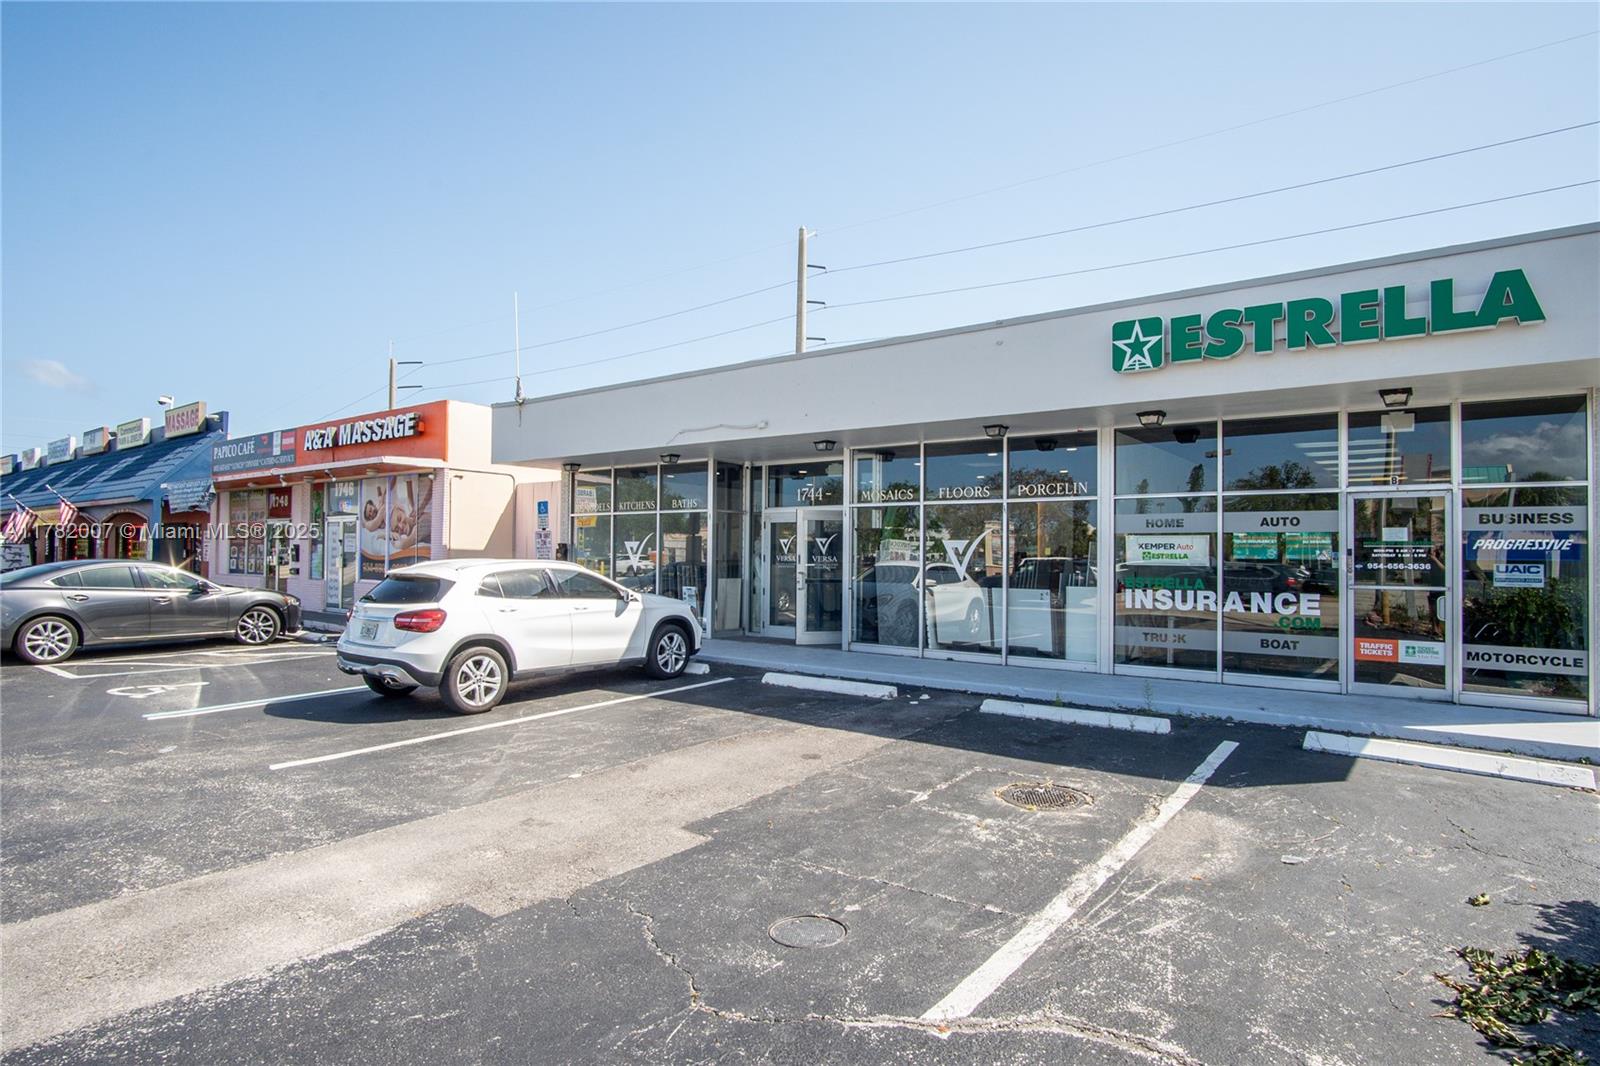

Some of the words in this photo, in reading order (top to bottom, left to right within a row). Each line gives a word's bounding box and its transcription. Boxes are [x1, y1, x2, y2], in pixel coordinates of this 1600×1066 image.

[1170, 268, 1546, 364] ESTRELLA
[165, 407, 200, 433] MASSAGE
[304, 427, 335, 451] A&A
[339, 412, 416, 446] MASSAGE
[213, 443, 237, 460] PAPICO
[238, 437, 256, 455] CAFÉ
[335, 482, 355, 497] 1746
[797, 488, 823, 501] 1744
[861, 489, 914, 501] MOSAICS
[938, 486, 990, 499] FLOORS
[1018, 481, 1089, 497] PORCELIN
[619, 501, 656, 511] KITCHENS
[672, 499, 698, 509] BATHS
[1145, 518, 1185, 528] HOME
[1260, 516, 1300, 527] AUTO
[1478, 512, 1574, 525] BUSINESS
[1472, 538, 1574, 550] PROGRESSIVE
[1496, 565, 1541, 574] UAIC
[1124, 576, 1205, 590] ESTRELLA
[1124, 588, 1321, 616] INSURANCE
[1274, 616, 1321, 631] .COM
[1260, 639, 1300, 650] BOAT
[1360, 642, 1393, 650] TRAFFIC
[1466, 651, 1584, 668] MOTORCYCLE
